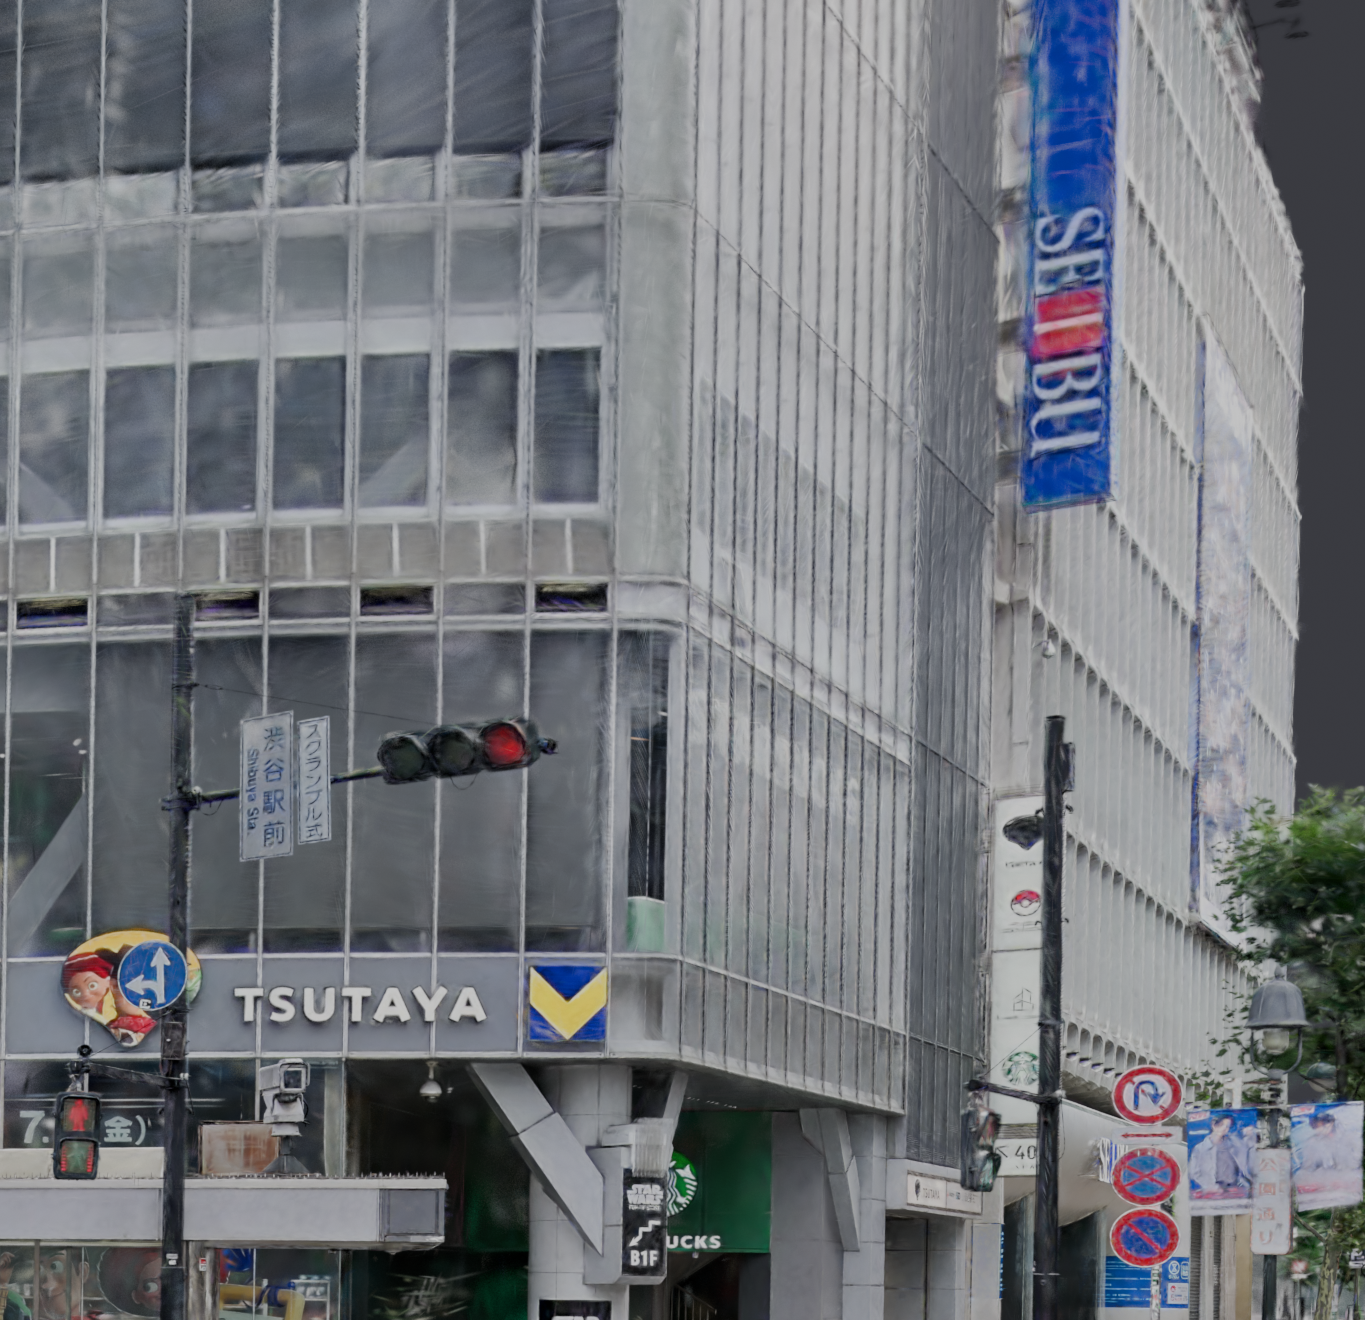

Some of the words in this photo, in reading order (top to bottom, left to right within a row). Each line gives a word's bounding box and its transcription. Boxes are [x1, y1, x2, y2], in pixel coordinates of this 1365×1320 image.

[1030, 206, 1105, 459] SEIBU
[246, 748, 260, 802] Shibuya
[262, 726, 286, 847] 渋谷駅前
[305, 724, 323, 839] スクランブル式
[234, 985, 487, 1024] TSUTAYA
[627, 1193, 664, 1205] WARS
[629, 1183, 663, 1196] STAR
[1257, 1157, 1278, 1245] 公園通り
[630, 1250, 658, 1267] B1F
